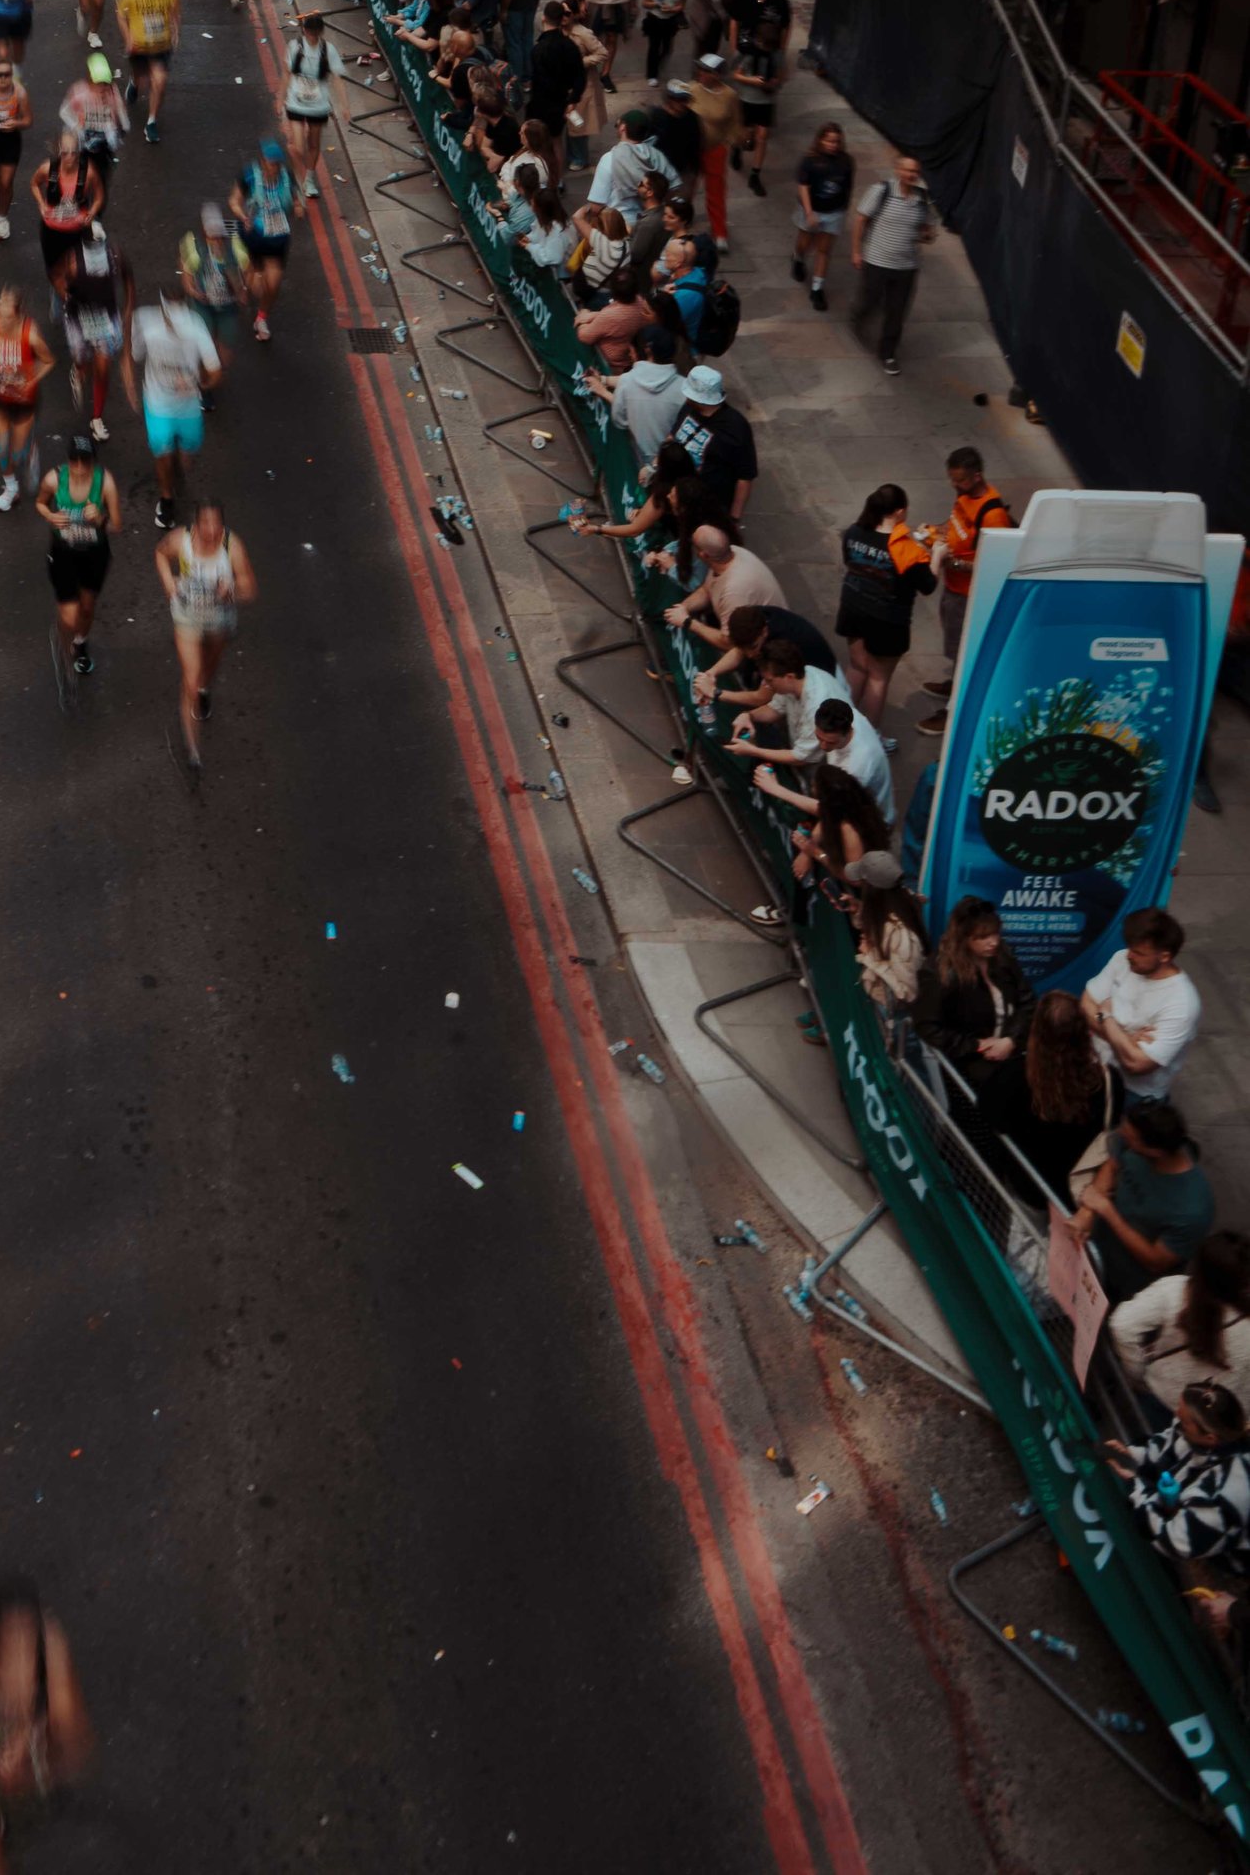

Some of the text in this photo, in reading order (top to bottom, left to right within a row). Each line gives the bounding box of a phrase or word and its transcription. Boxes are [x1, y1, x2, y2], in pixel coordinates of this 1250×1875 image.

[508, 266, 552, 339] RADOX
[1023, 739, 1127, 768] MINERAL
[984, 789, 1142, 823] RADOX
[1004, 841, 1104, 869] THERAPY
[1022, 875, 1063, 889] FEEL
[1000, 889, 1079, 908] AWAKE
